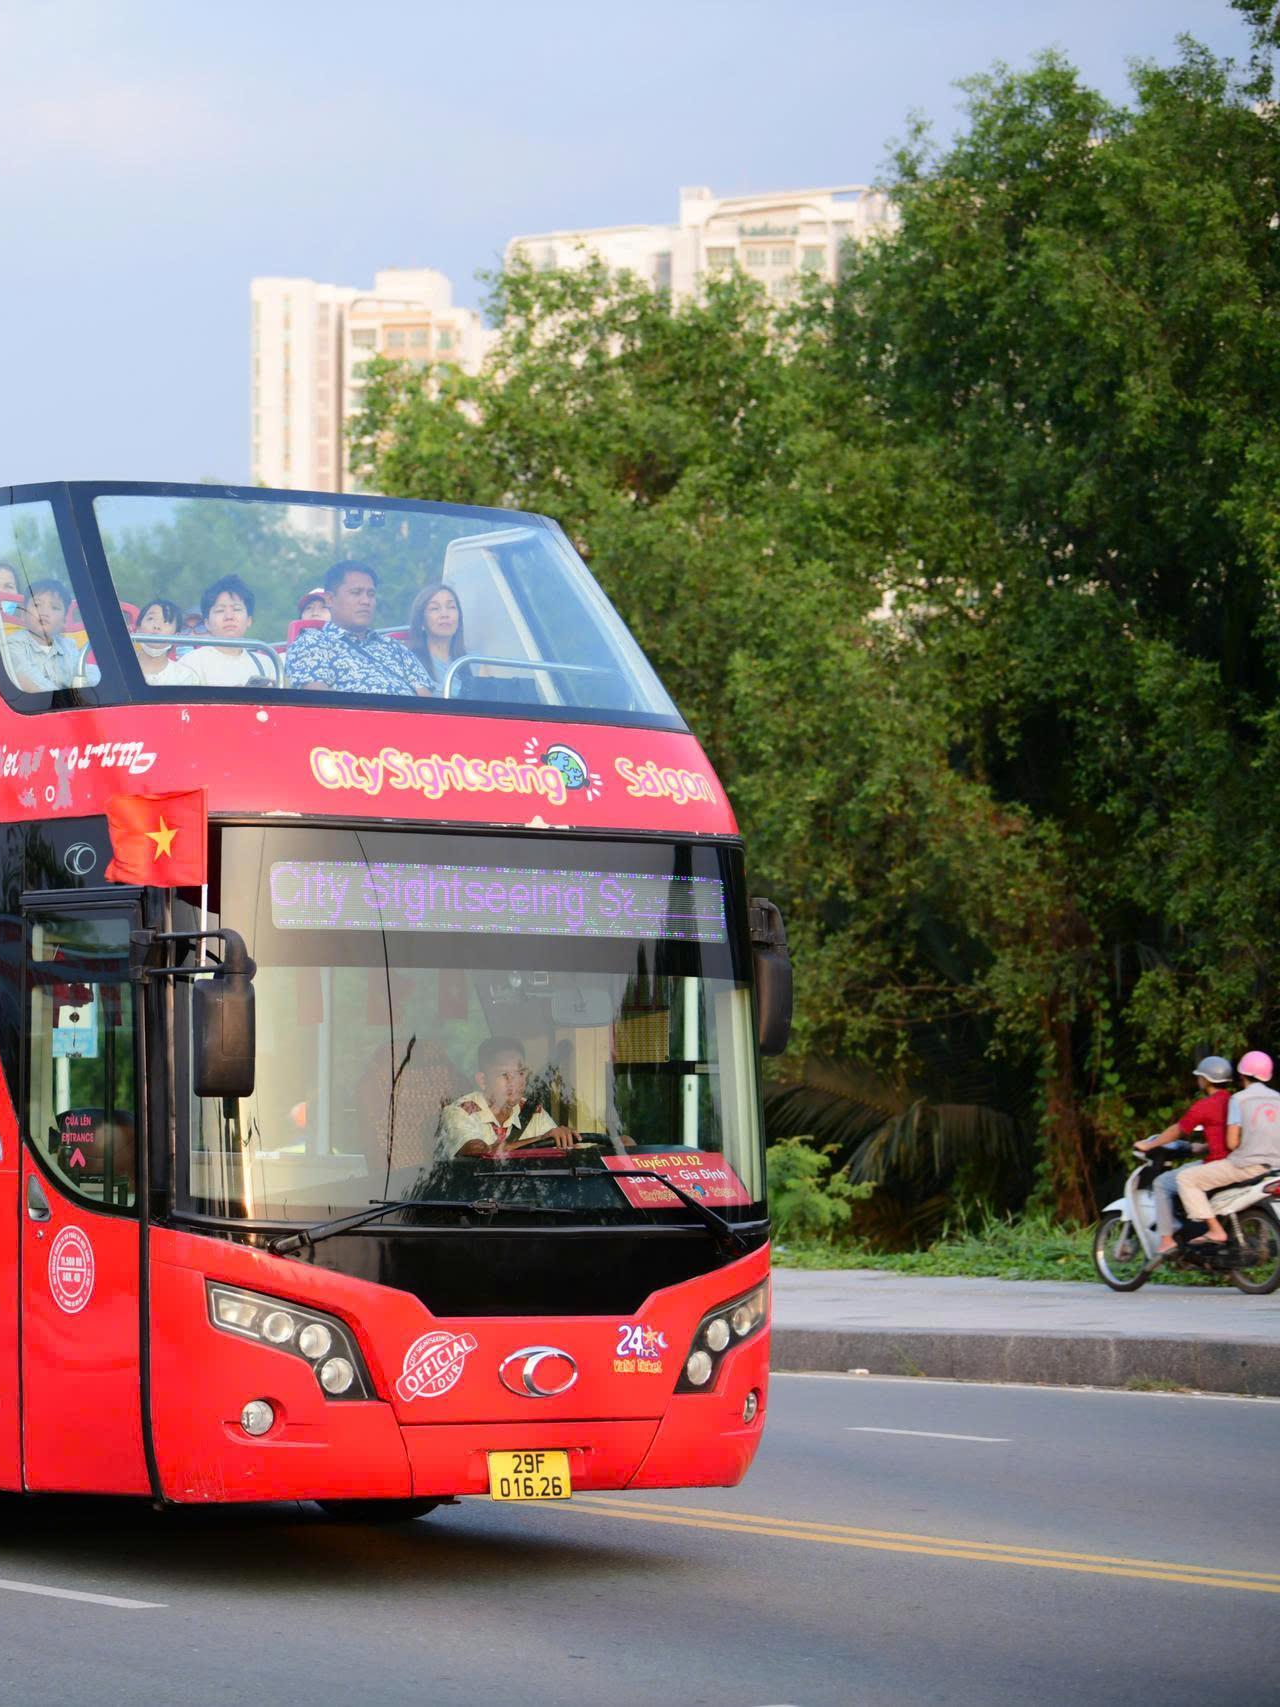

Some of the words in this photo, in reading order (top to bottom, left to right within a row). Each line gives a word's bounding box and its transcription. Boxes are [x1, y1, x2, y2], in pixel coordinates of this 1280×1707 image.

[615, 757, 717, 805] Saigon
[270, 866, 351, 921] City
[360, 868, 584, 929] Sightseeing
[61, 1132, 95, 1143] ENTRANCE
[679, 1169, 700, 1181] Gia
[700, 1168, 727, 1182] Định
[616, 1324, 644, 1357] 24
[404, 1337, 473, 1393] OFFICIAL
[431, 1363, 461, 1391] TOUR
[511, 1453, 545, 1474] 29F
[500, 1476, 563, 1498] 016.26
